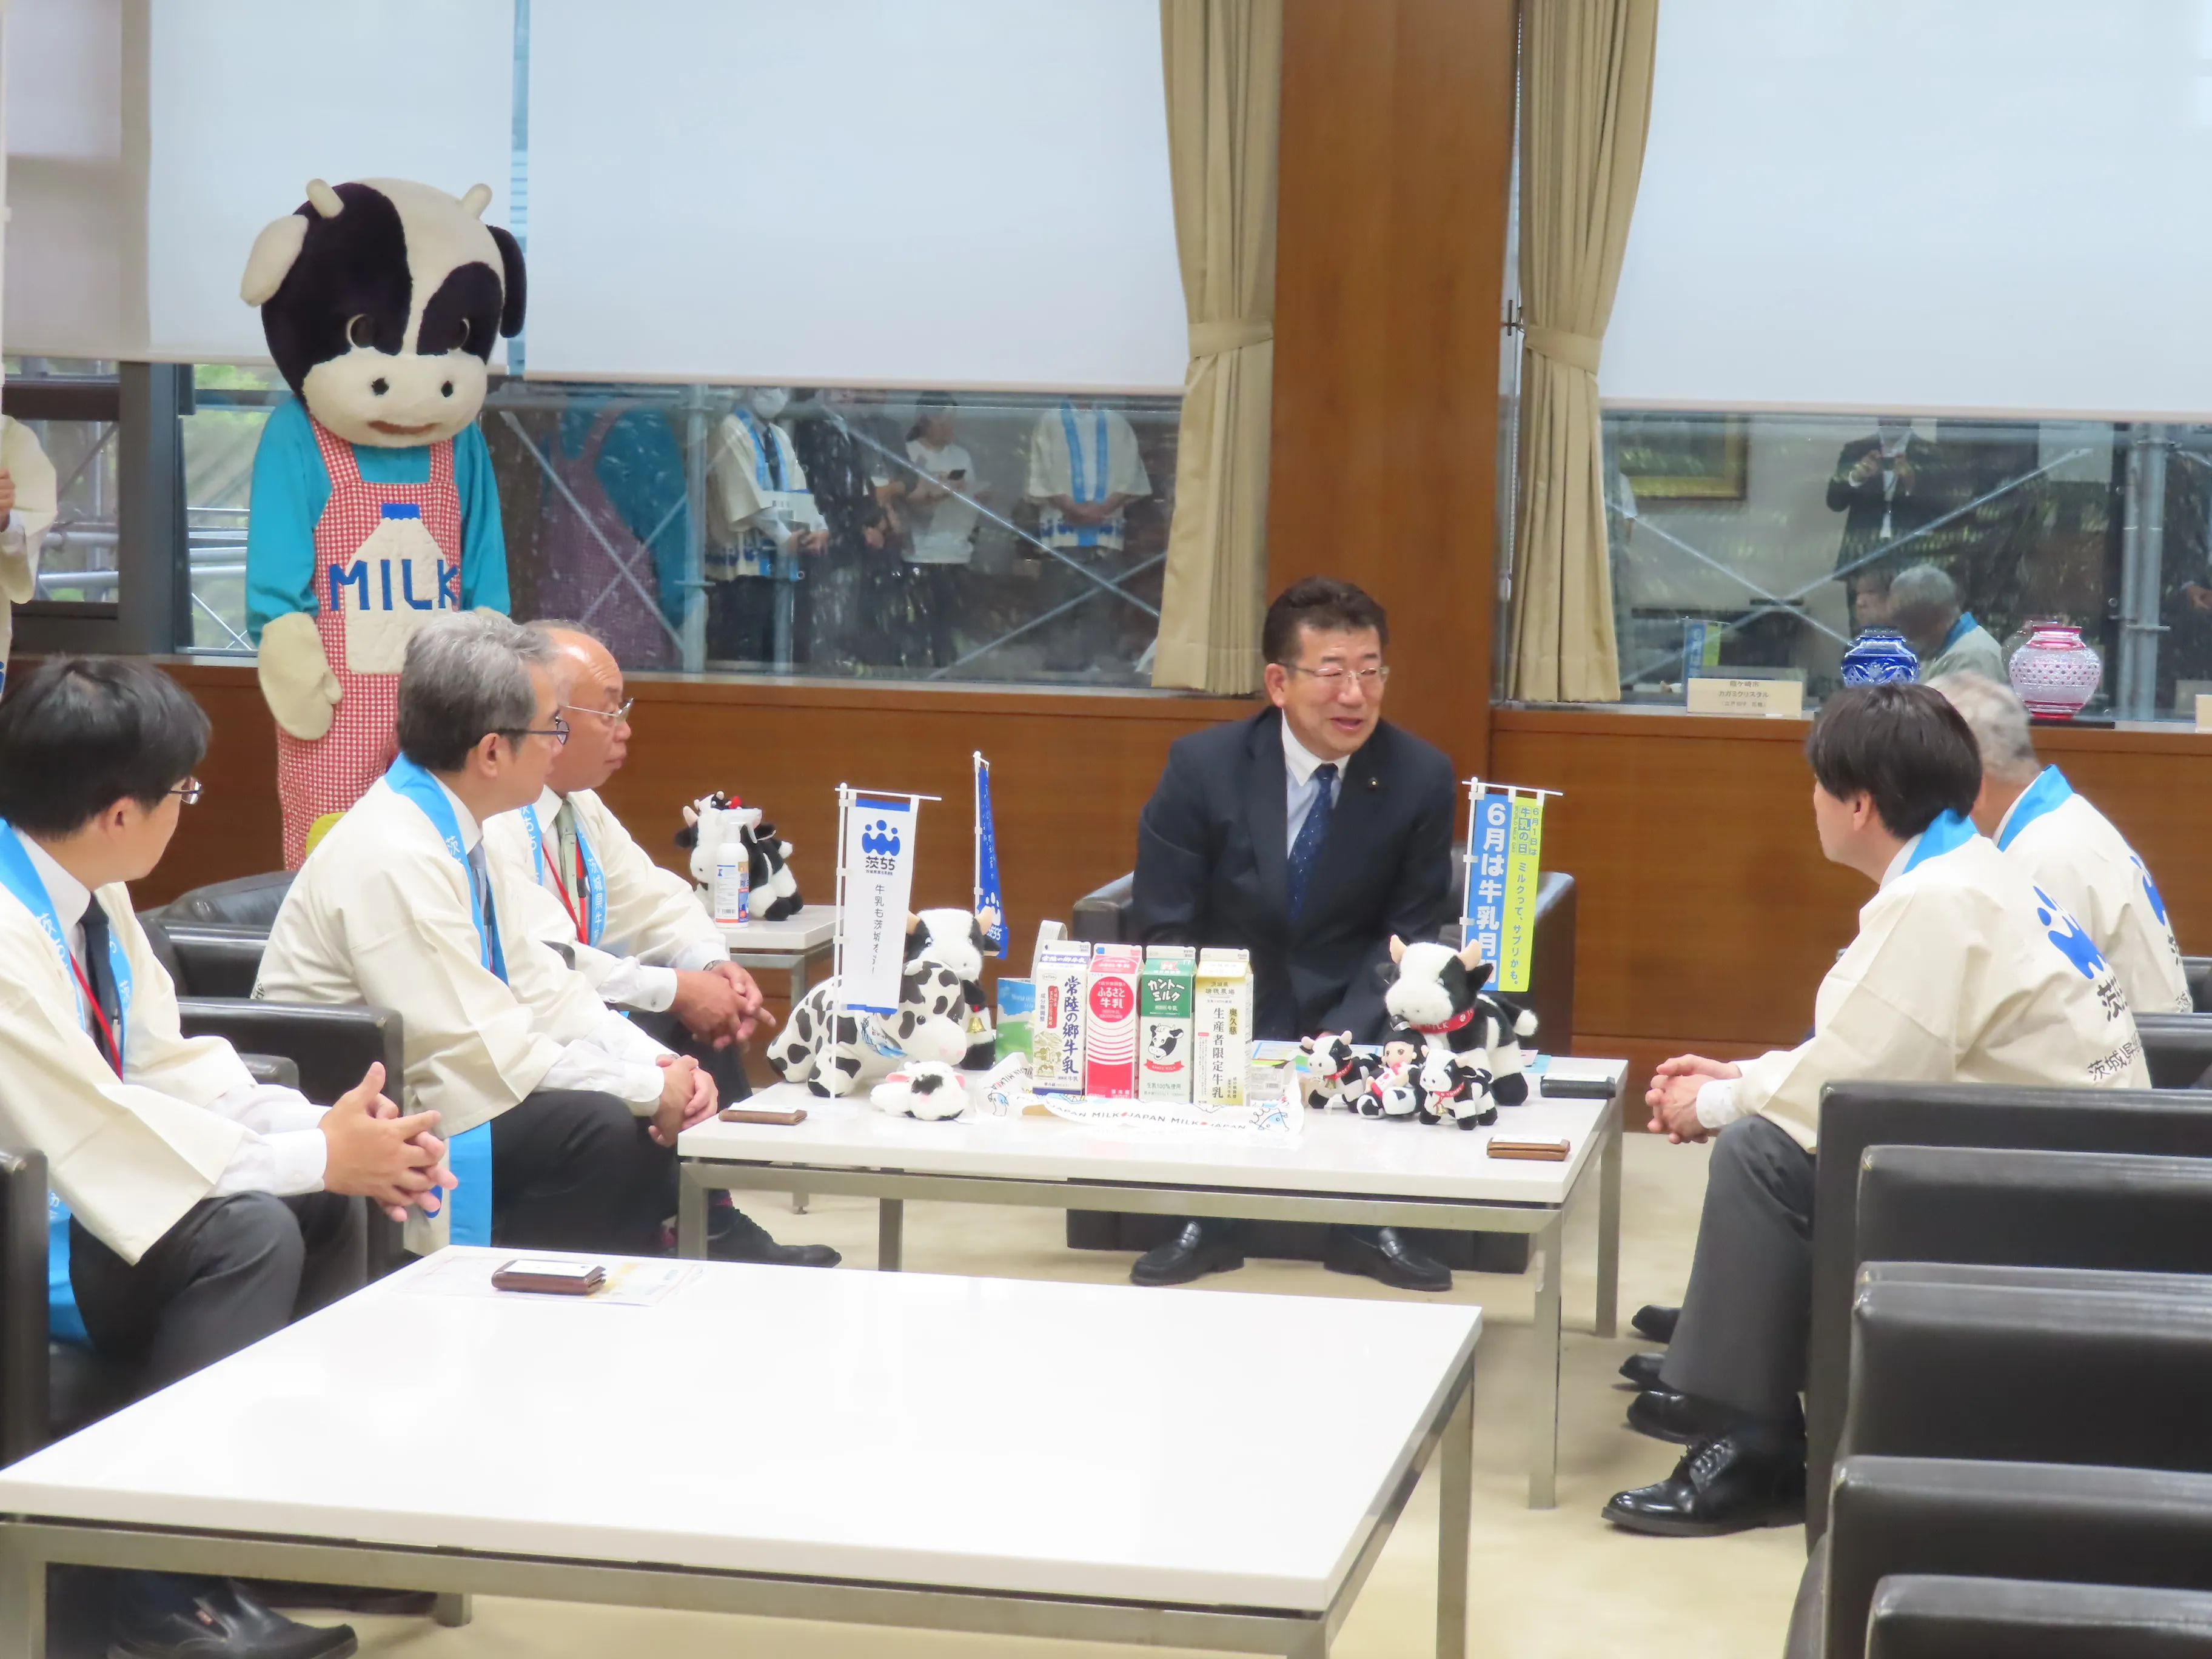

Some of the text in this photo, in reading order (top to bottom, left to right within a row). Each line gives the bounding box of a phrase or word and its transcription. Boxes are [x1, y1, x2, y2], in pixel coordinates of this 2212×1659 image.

[329, 559, 460, 611] MILK
[1517, 806, 1531, 854] 牛乳の日
[1529, 808, 1540, 856] 6月1日は
[1097, 987, 1125, 997] ふるさと
[1147, 977, 1185, 991] カントー
[1152, 990, 1181, 1002] ミルク
[1099, 997, 1124, 1009] 牛乳
[1062, 975, 1082, 1074] 常陸の郷牛乳
[1228, 1008, 1238, 1036] 奥久慈
[1212, 1007, 1225, 1099] 生産者限定牛乳
[1127, 1112, 1166, 1122] JAPAN
